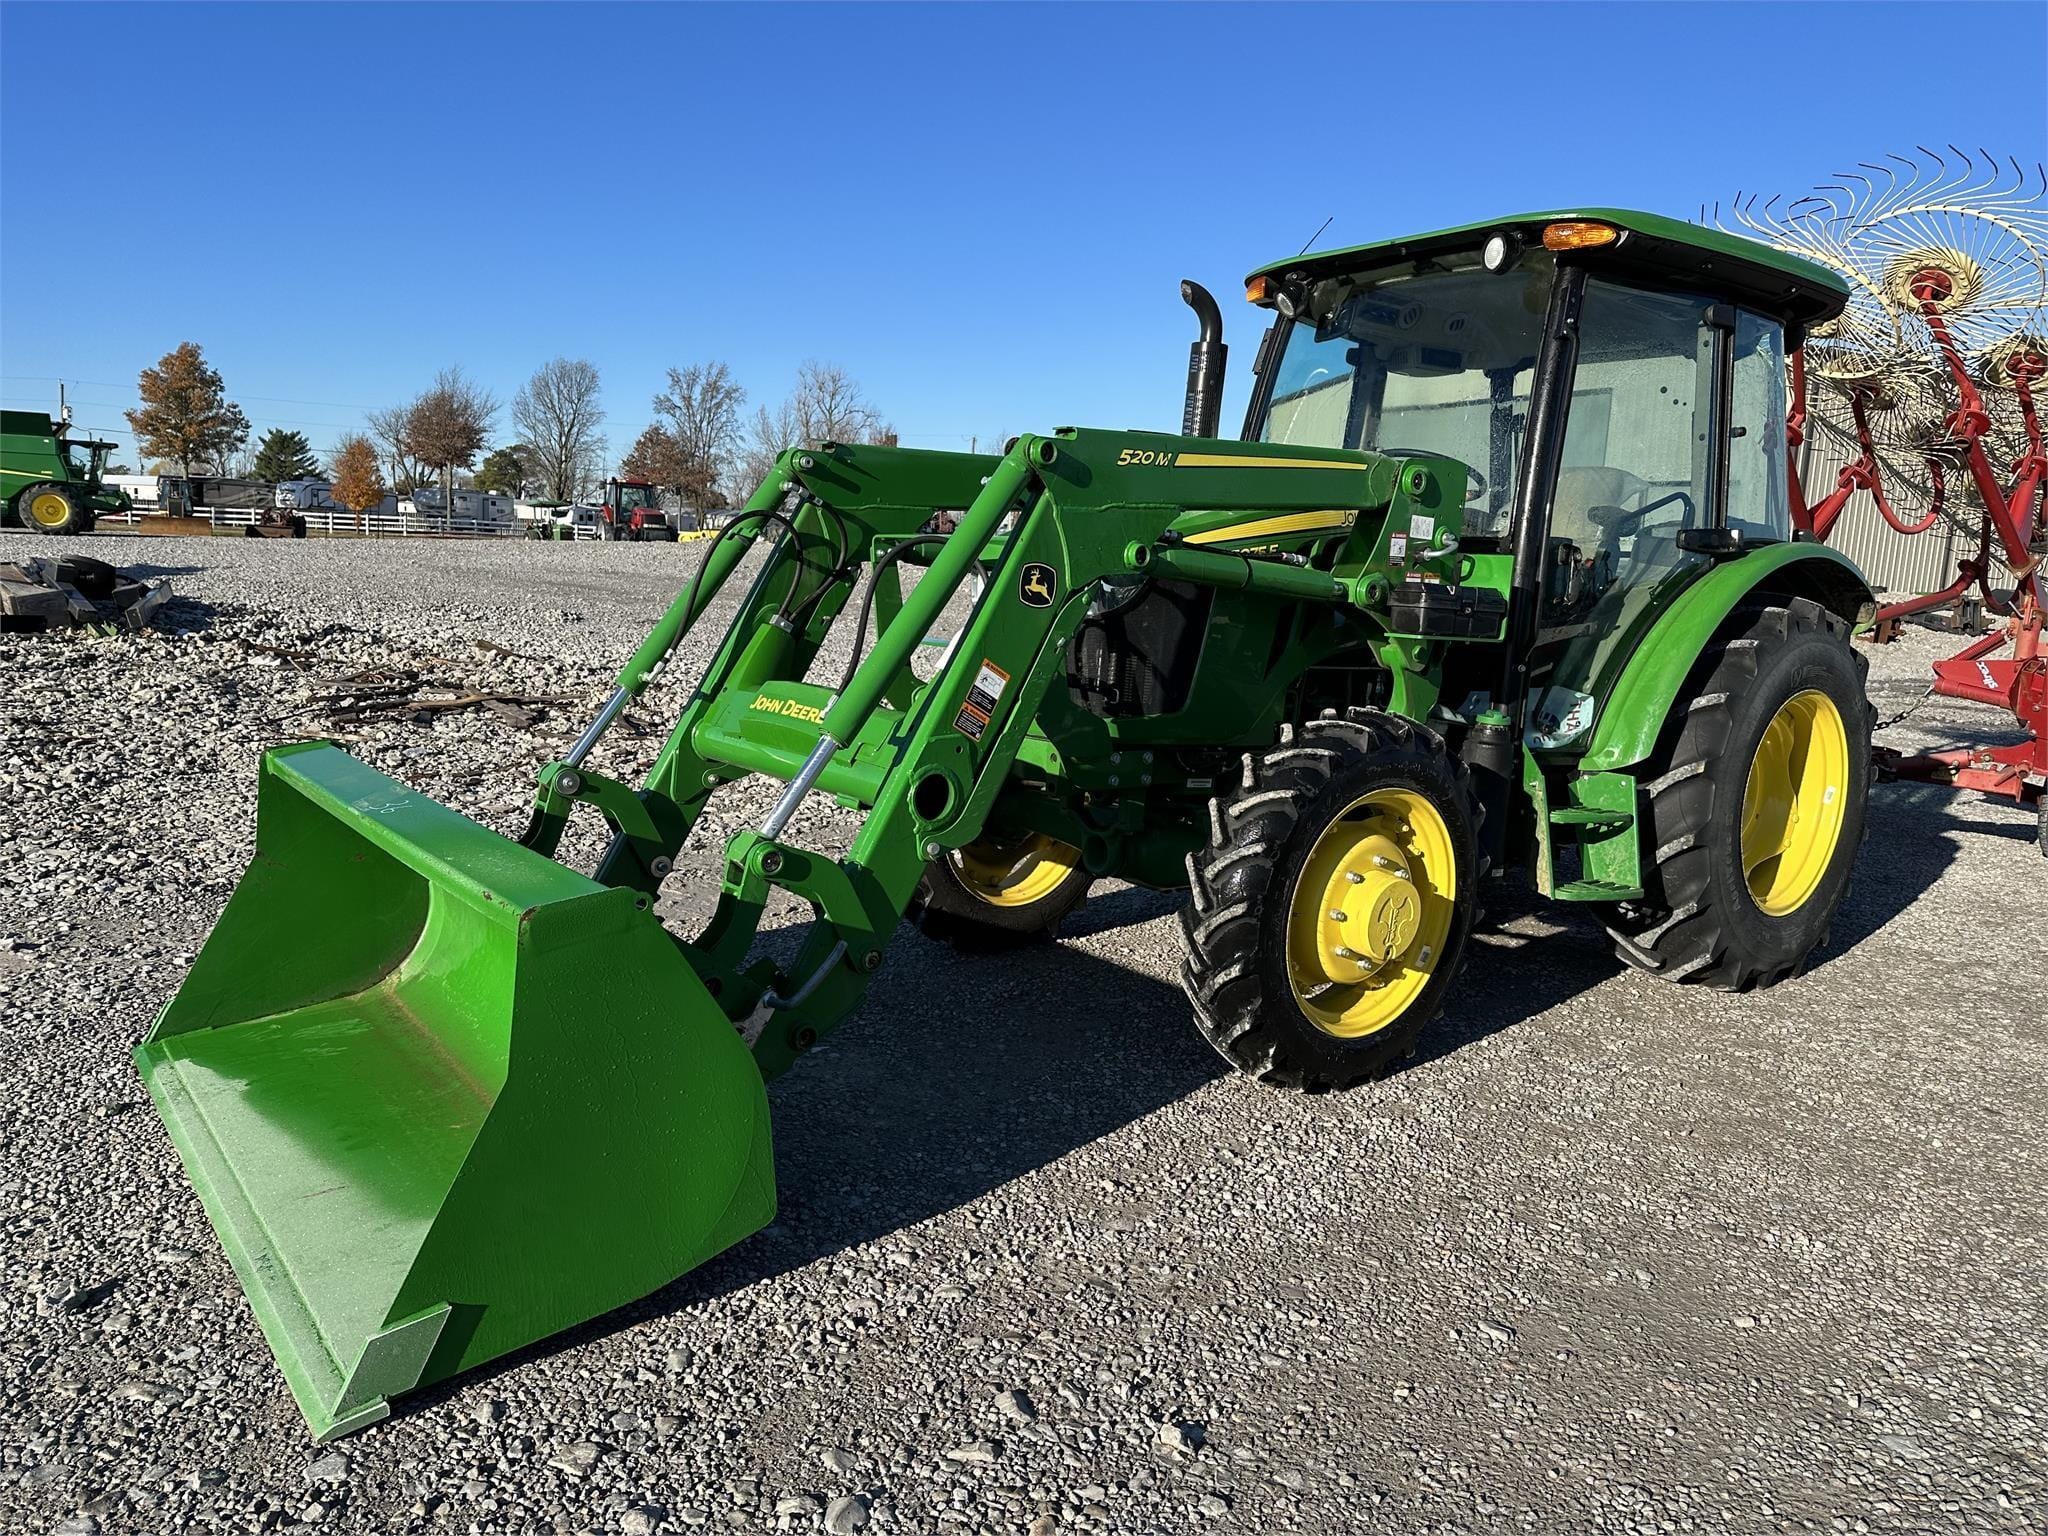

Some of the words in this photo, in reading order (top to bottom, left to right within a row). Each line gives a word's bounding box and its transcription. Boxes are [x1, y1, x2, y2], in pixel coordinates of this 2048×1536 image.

[1117, 449, 1155, 466] 520
[1155, 452, 1173, 466] M
[749, 694, 784, 713] JOHN
